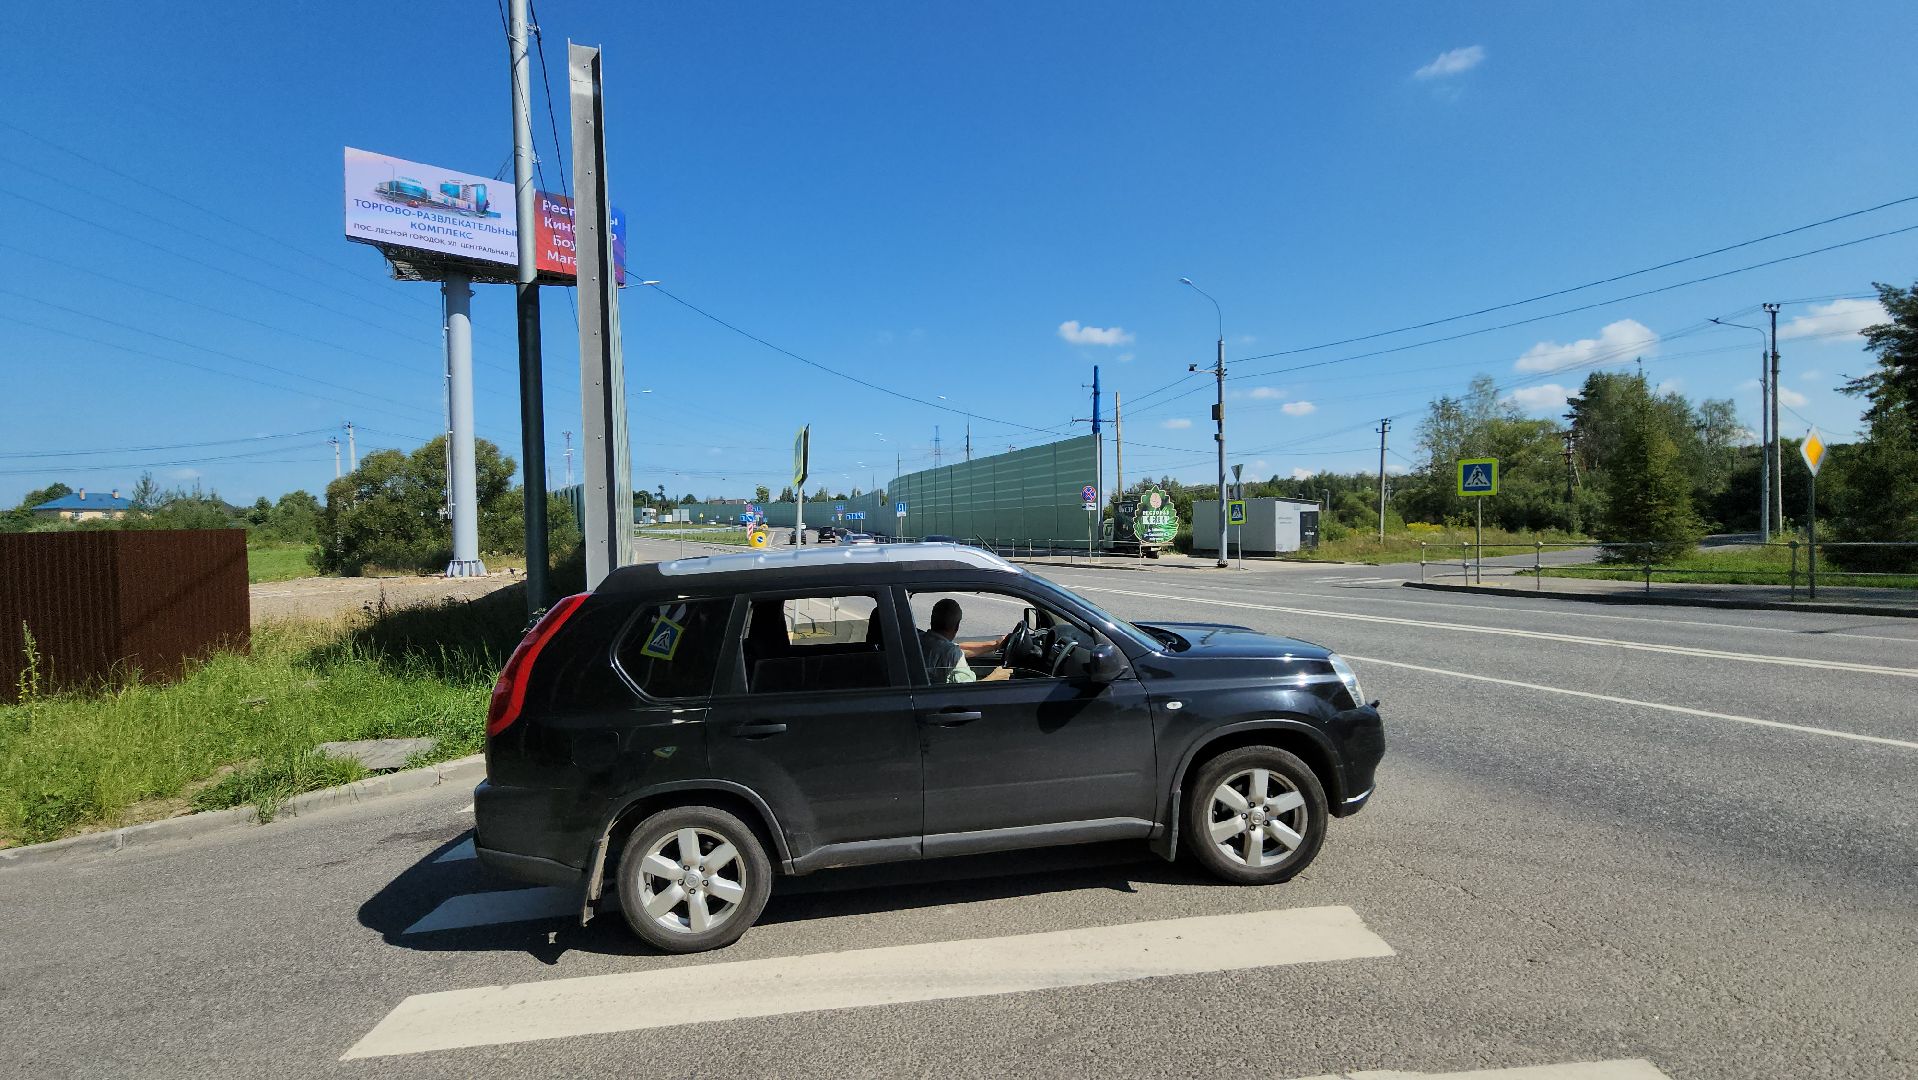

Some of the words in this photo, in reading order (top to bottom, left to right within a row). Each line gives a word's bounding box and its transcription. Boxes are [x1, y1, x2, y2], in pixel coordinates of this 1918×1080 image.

[353, 198, 518, 237] ТОРГОВО-РАЗВЛЕКАТЕЛЬНЫ
[410, 221, 473, 240] КОМПЛЕКС
[375, 226, 408, 238] ЛЕСНОЙ
[460, 242, 509, 257] ЦЕНТРАЛЬНАЯ
